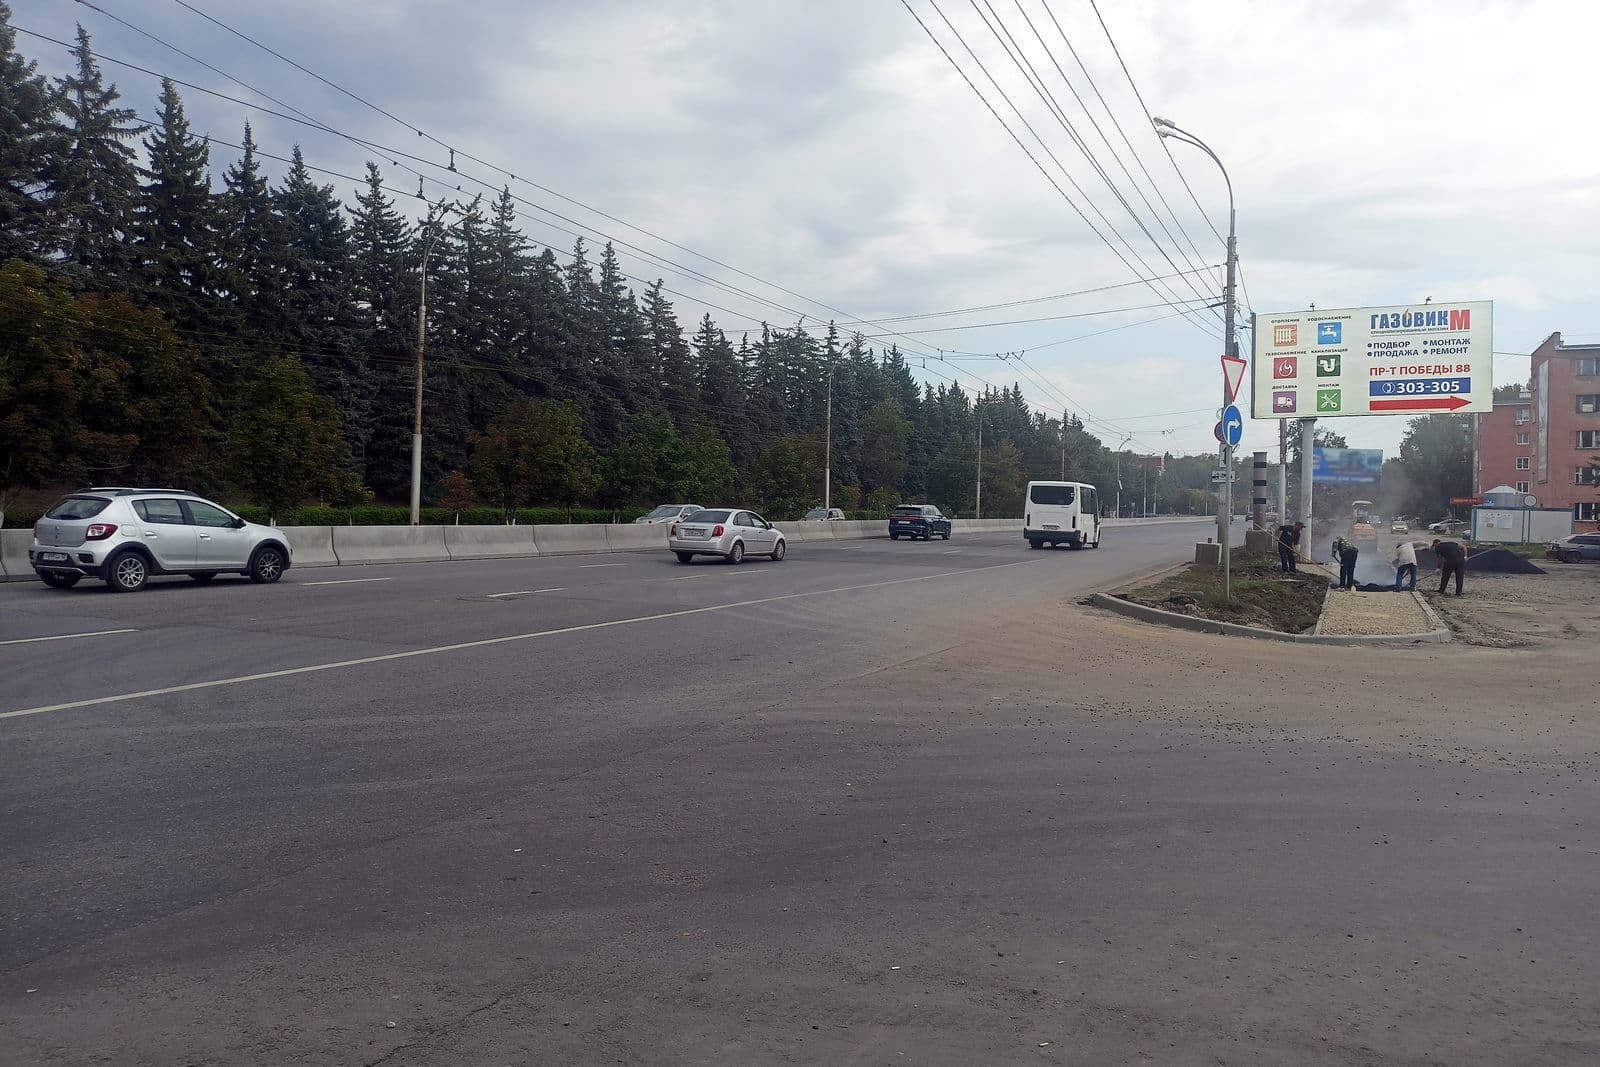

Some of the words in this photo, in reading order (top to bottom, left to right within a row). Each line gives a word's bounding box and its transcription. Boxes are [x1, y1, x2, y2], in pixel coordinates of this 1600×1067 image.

[1373, 341, 1411, 349] ПОДБОР
[1429, 338, 1471, 346] МОНТАЖ
[1373, 349, 1419, 358] ПРОДАЖА
[1430, 347, 1468, 355] РЕМОНТ
[1369, 367, 1397, 376] ПР-Т
[1399, 365, 1453, 375] ПОБЕДЫ
[1456, 364, 1471, 372] 88
[1397, 381, 1460, 394] 303-305
